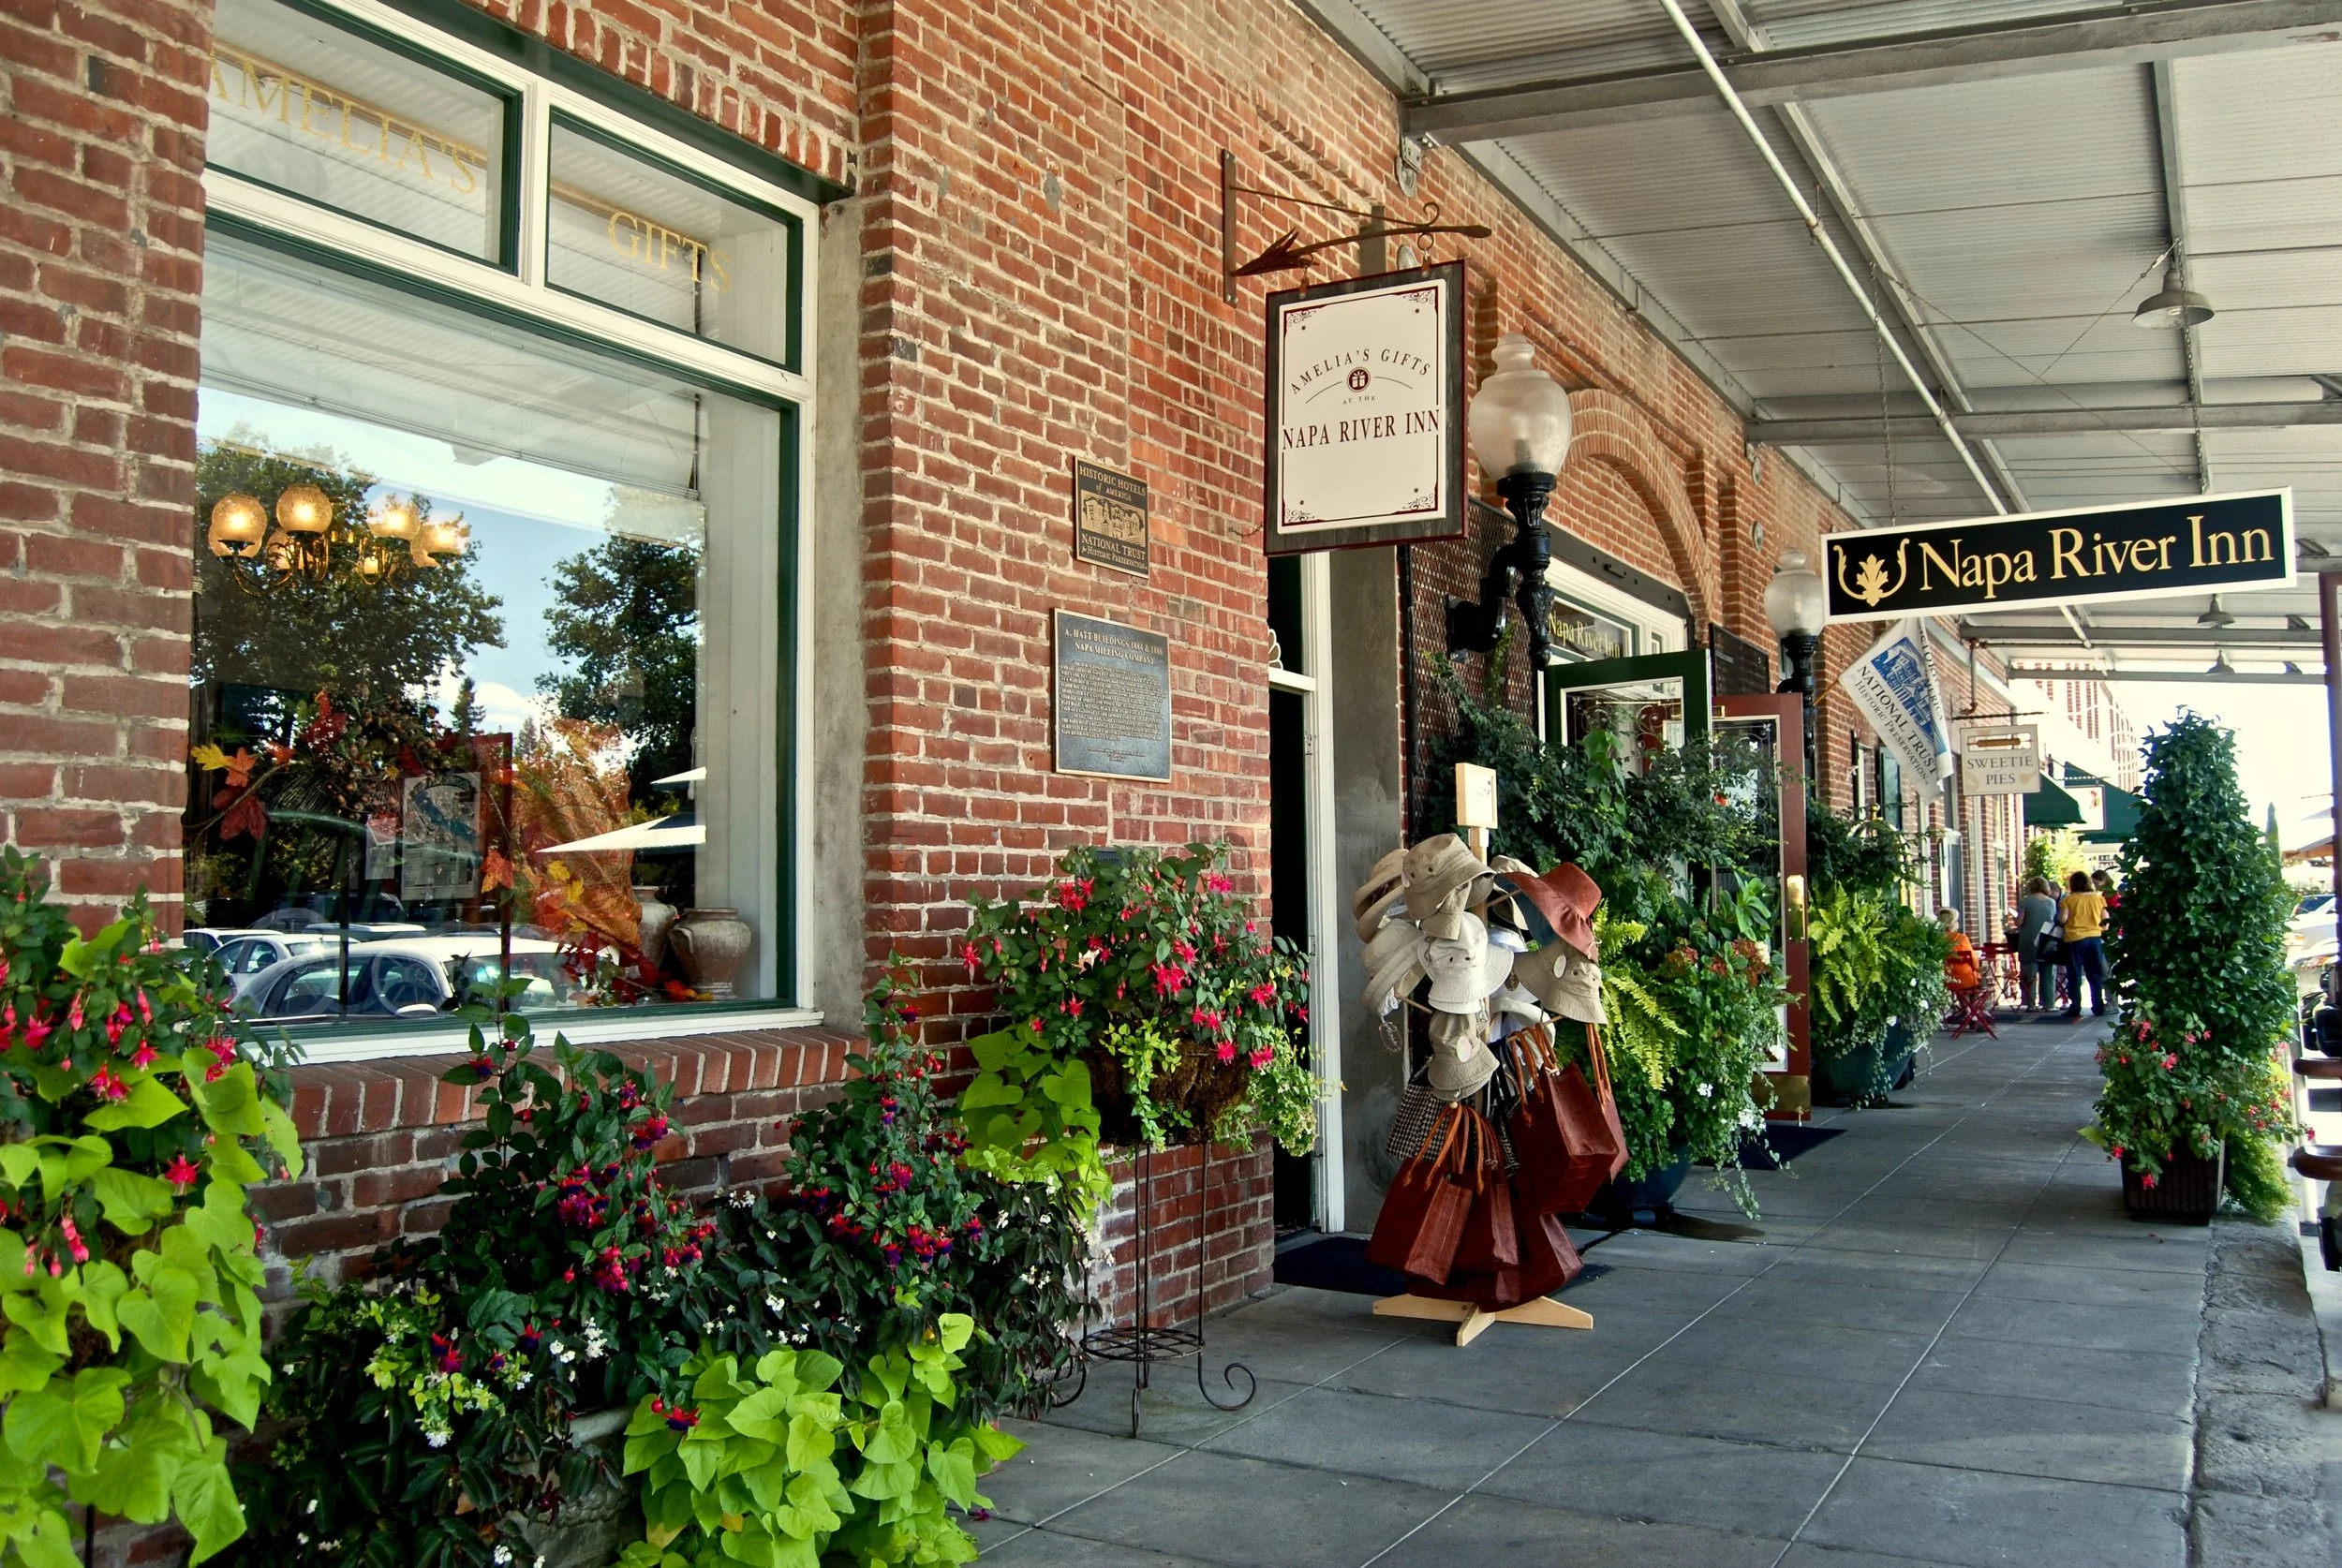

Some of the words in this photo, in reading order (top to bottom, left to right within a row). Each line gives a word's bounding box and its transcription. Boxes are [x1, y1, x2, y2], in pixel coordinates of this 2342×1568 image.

[608, 212, 731, 292] GIFTS
[1290, 348, 1370, 395] AMELIA'S
[1381, 348, 1430, 377] GIFTS
[1342, 397, 1353, 406] AT
[1282, 423, 1330, 450] NAPA
[1340, 415, 1396, 443] RIVER
[1405, 409, 1440, 435] INN
[1079, 466, 1117, 486] HISTORIC
[1118, 479, 1146, 496] HOTELS
[1105, 488, 1132, 502] AMERICA
[1081, 533, 1120, 554] NATIONAL
[1122, 545, 1146, 561] TRUST
[1918, 539, 2038, 599] Napa
[2048, 527, 2176, 579] River
[2186, 514, 2275, 568] Inn
[1064, 628, 1073, 637] A.
[1074, 629, 1092, 641] HATT
[1548, 611, 1575, 646] Napa
[1577, 620, 1602, 652] River
[1075, 641, 1093, 653] NAPA
[1855, 681, 1886, 721] HISTORIC
[1858, 665, 1908, 732] NATIONAL
[1905, 730, 1938, 774] TRUST
[1967, 755, 2034, 769] SWEETIE
[1986, 774, 2016, 785] PIES
